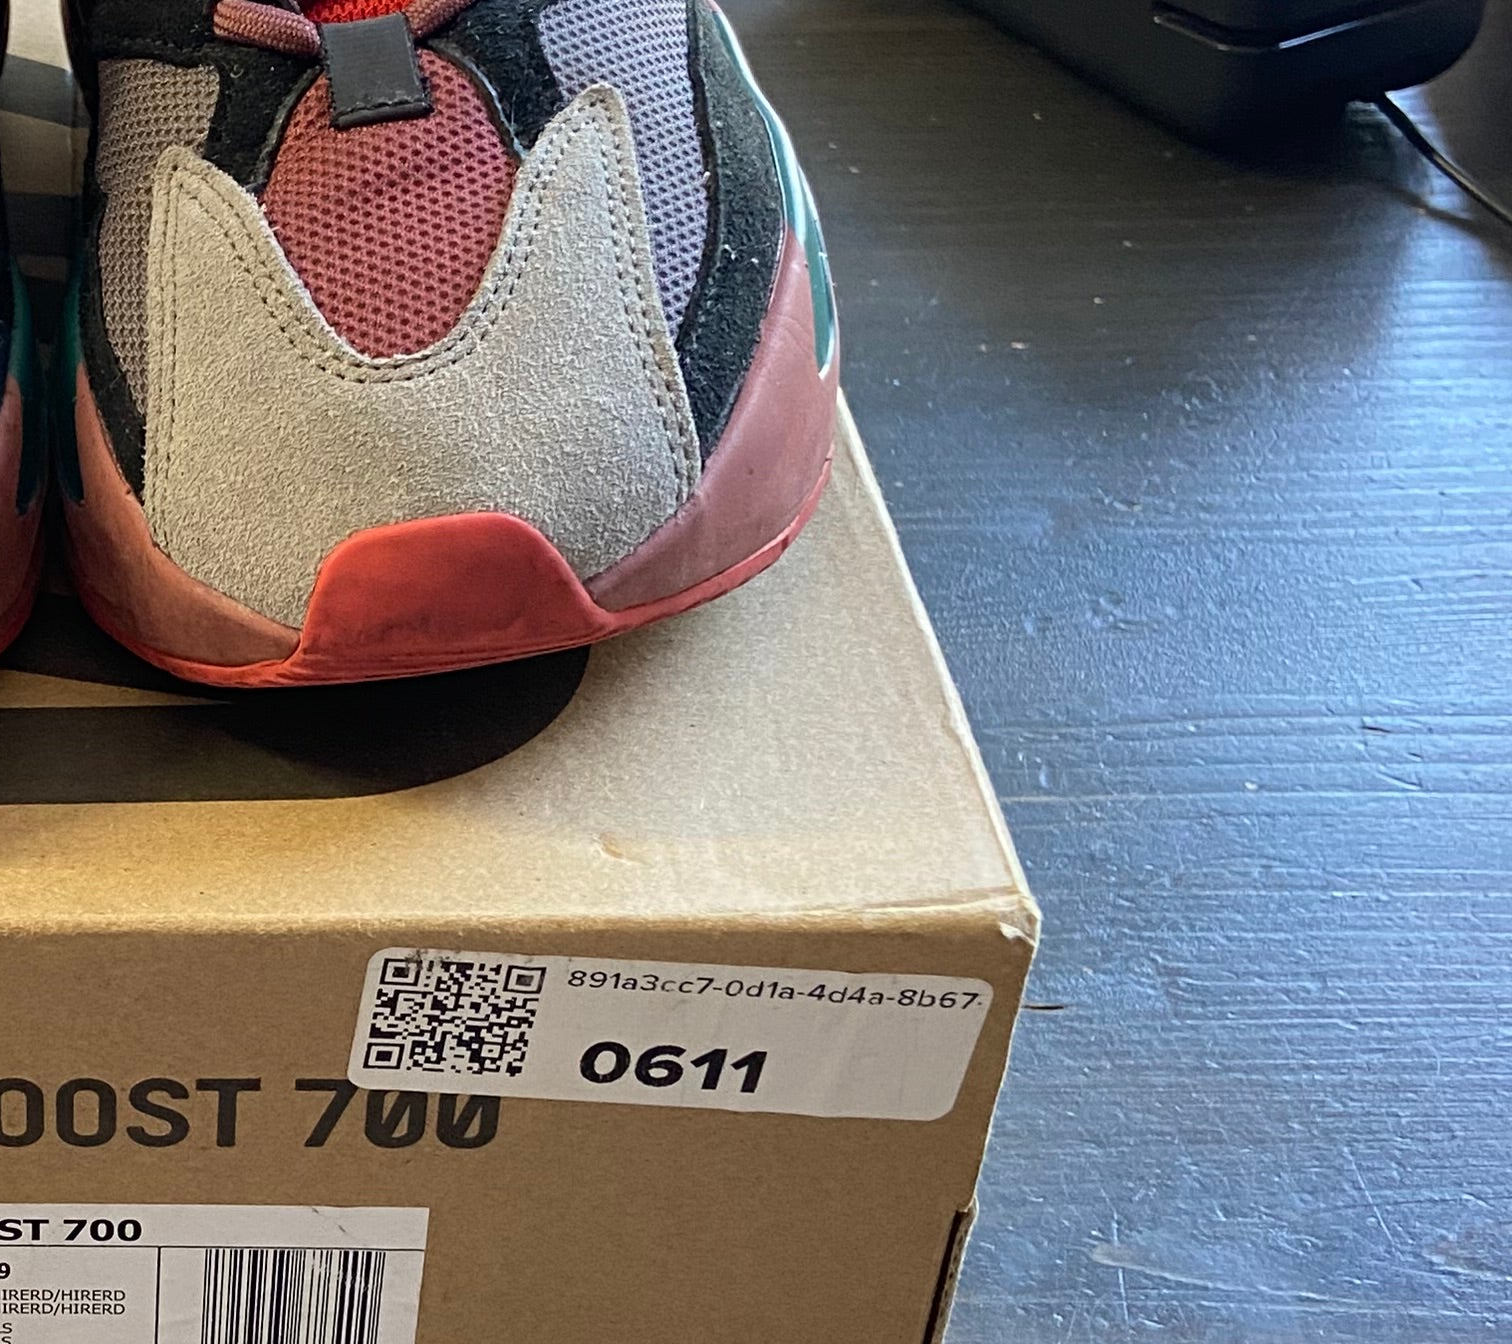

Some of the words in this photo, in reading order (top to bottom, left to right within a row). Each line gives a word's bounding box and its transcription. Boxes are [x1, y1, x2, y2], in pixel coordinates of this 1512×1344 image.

[580, 1041, 768, 1094] 0611
[295, 1078, 502, 1149] 700
[63, 1218, 142, 1242] 700
